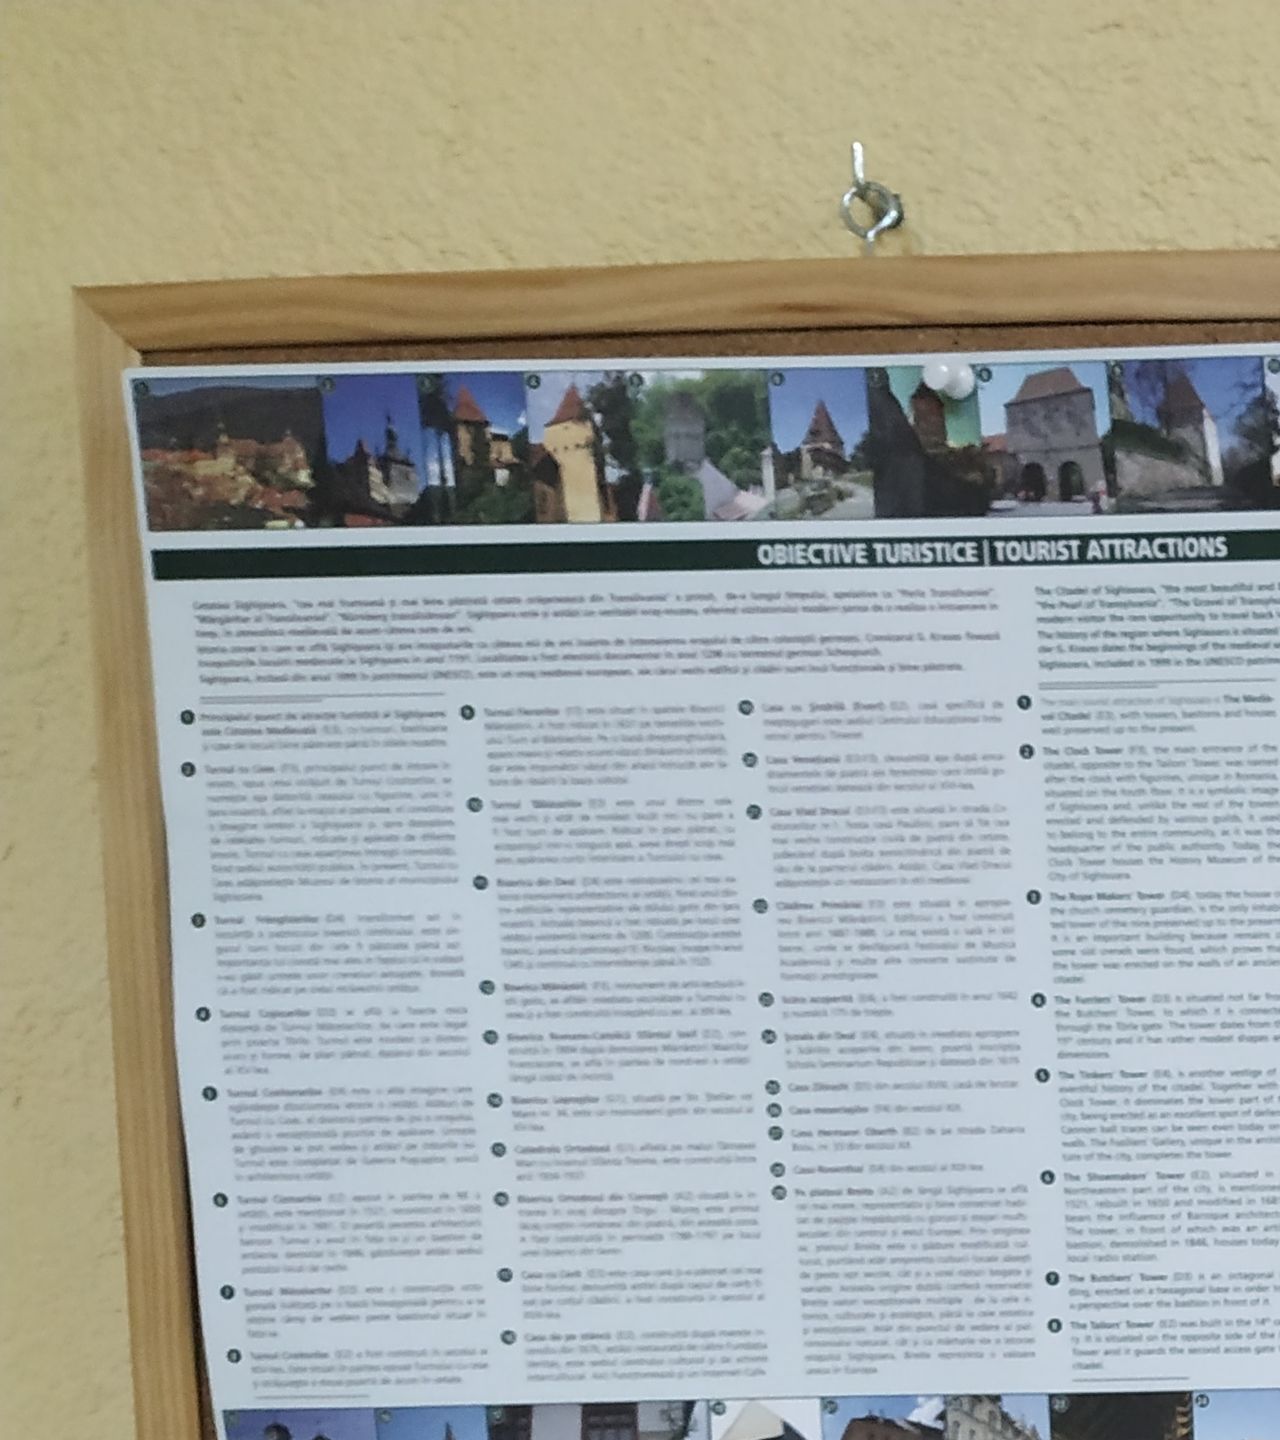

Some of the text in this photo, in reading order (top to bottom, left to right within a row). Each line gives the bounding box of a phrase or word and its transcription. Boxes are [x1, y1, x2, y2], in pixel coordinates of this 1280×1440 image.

[757, 535, 1228, 566] OBIECTIVE TURISTICE TOURIST ATTRACTIONS
